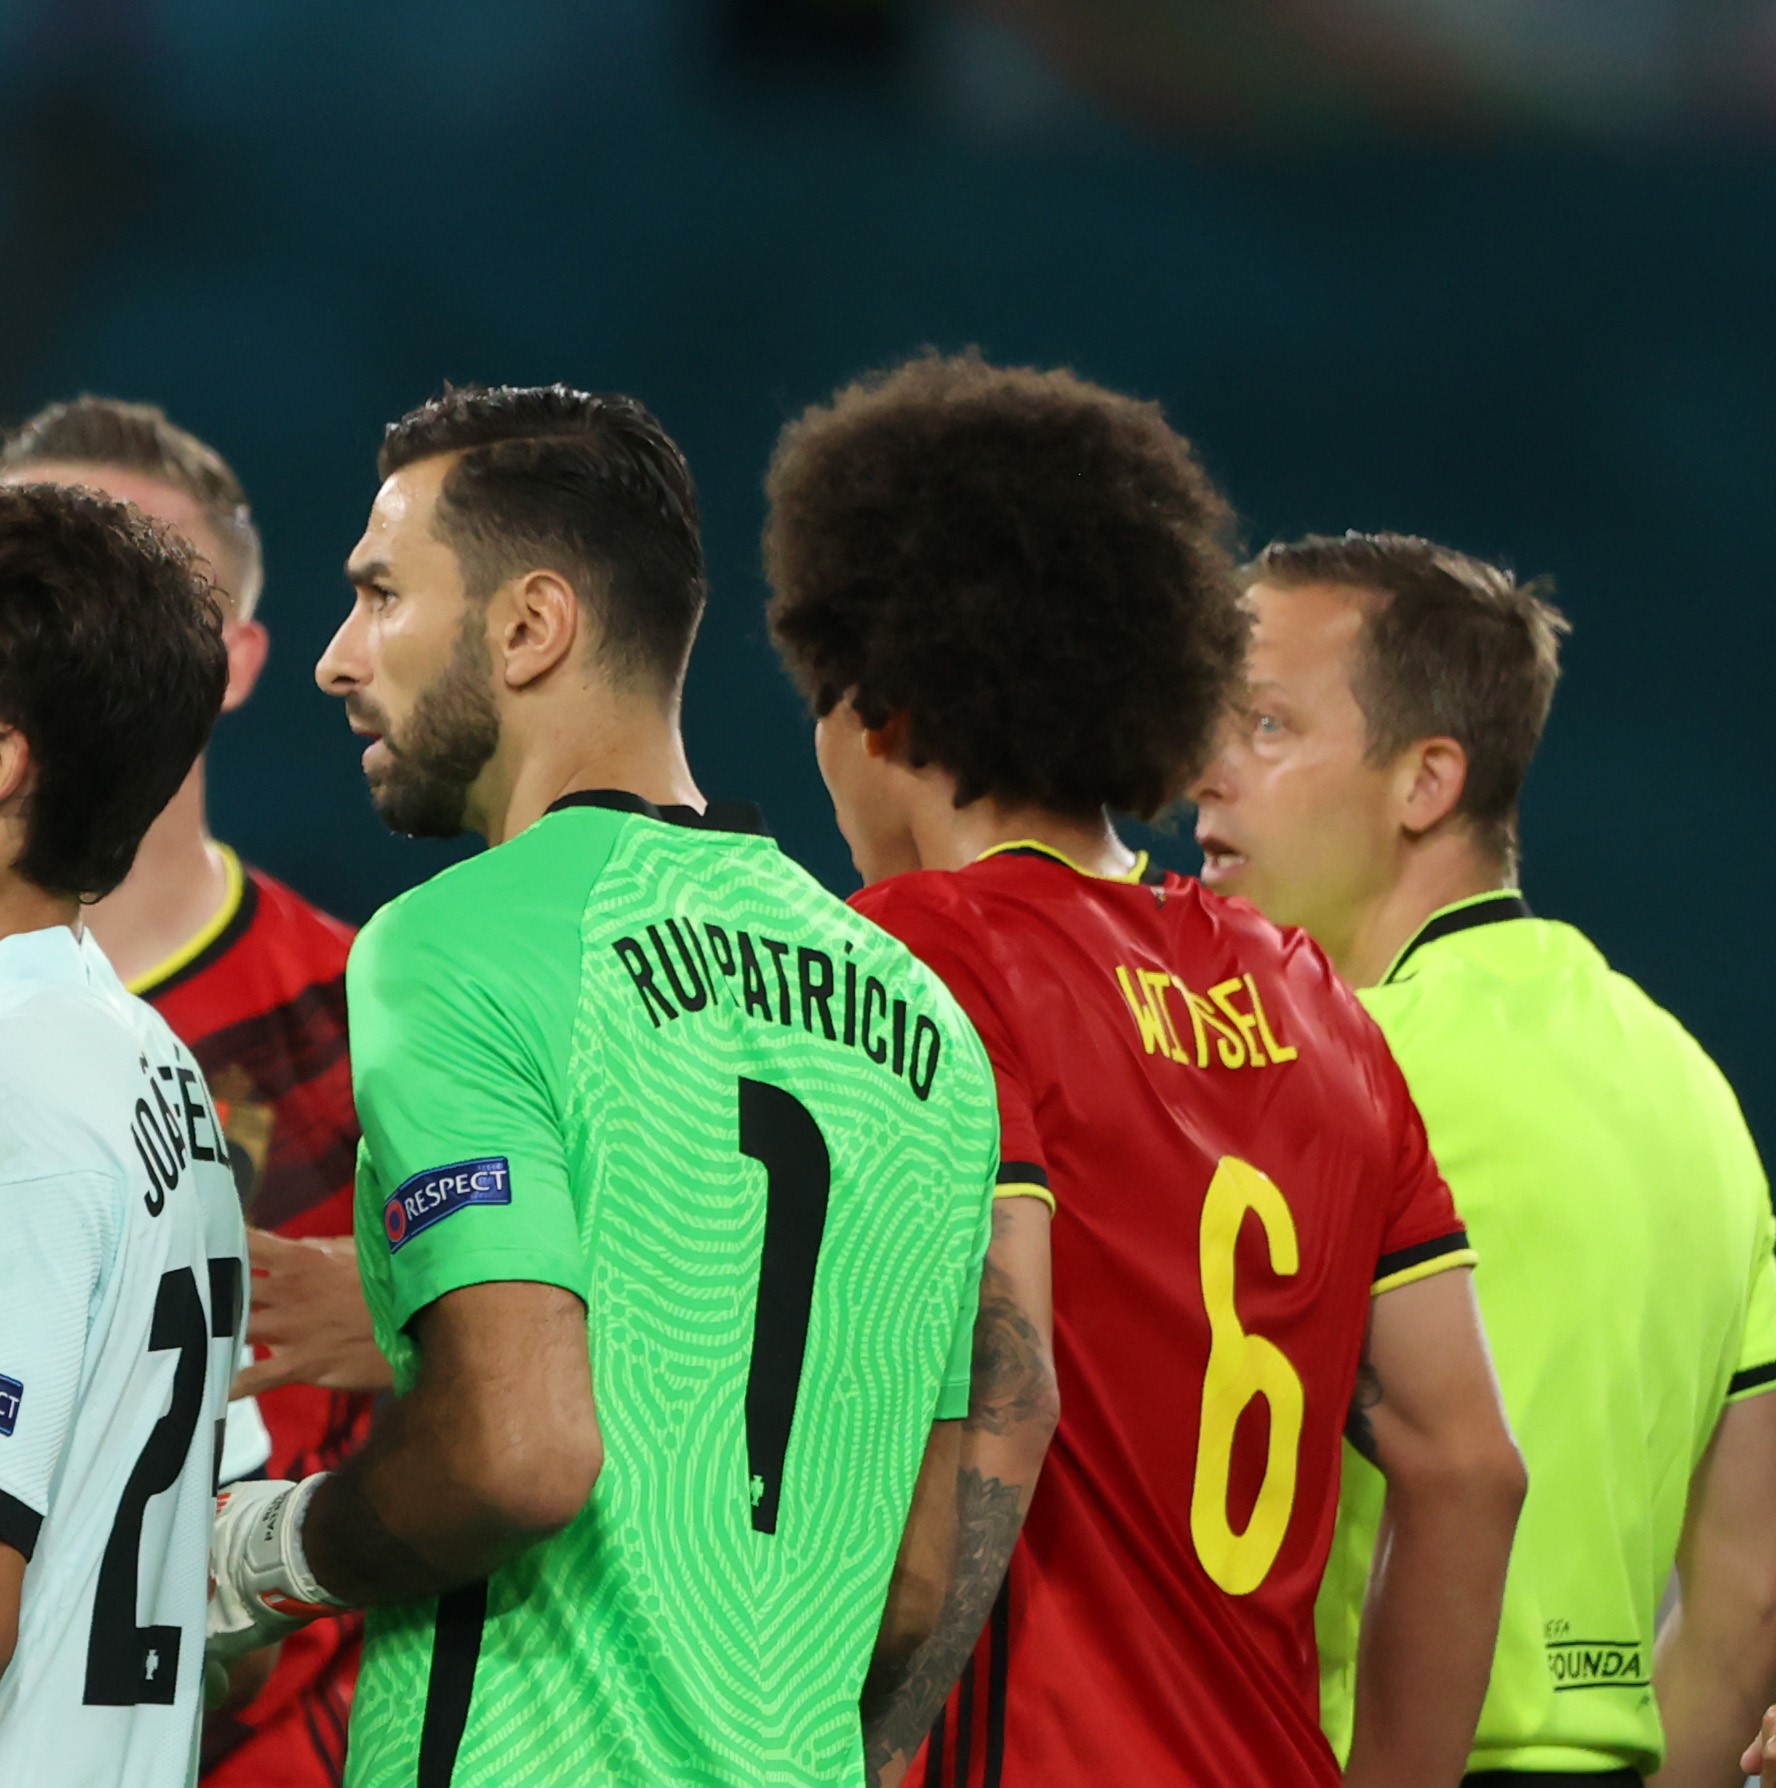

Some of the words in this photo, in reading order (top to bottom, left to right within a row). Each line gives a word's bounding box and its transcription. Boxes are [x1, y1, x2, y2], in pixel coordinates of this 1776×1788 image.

[611, 917, 718, 1029] RUI
[703, 922, 941, 1101] PATRÍCIO
[404, 1169, 507, 1221] RESPECT
[738, 1076, 831, 1536] 1
[1190, 1155, 1305, 1597] 6
